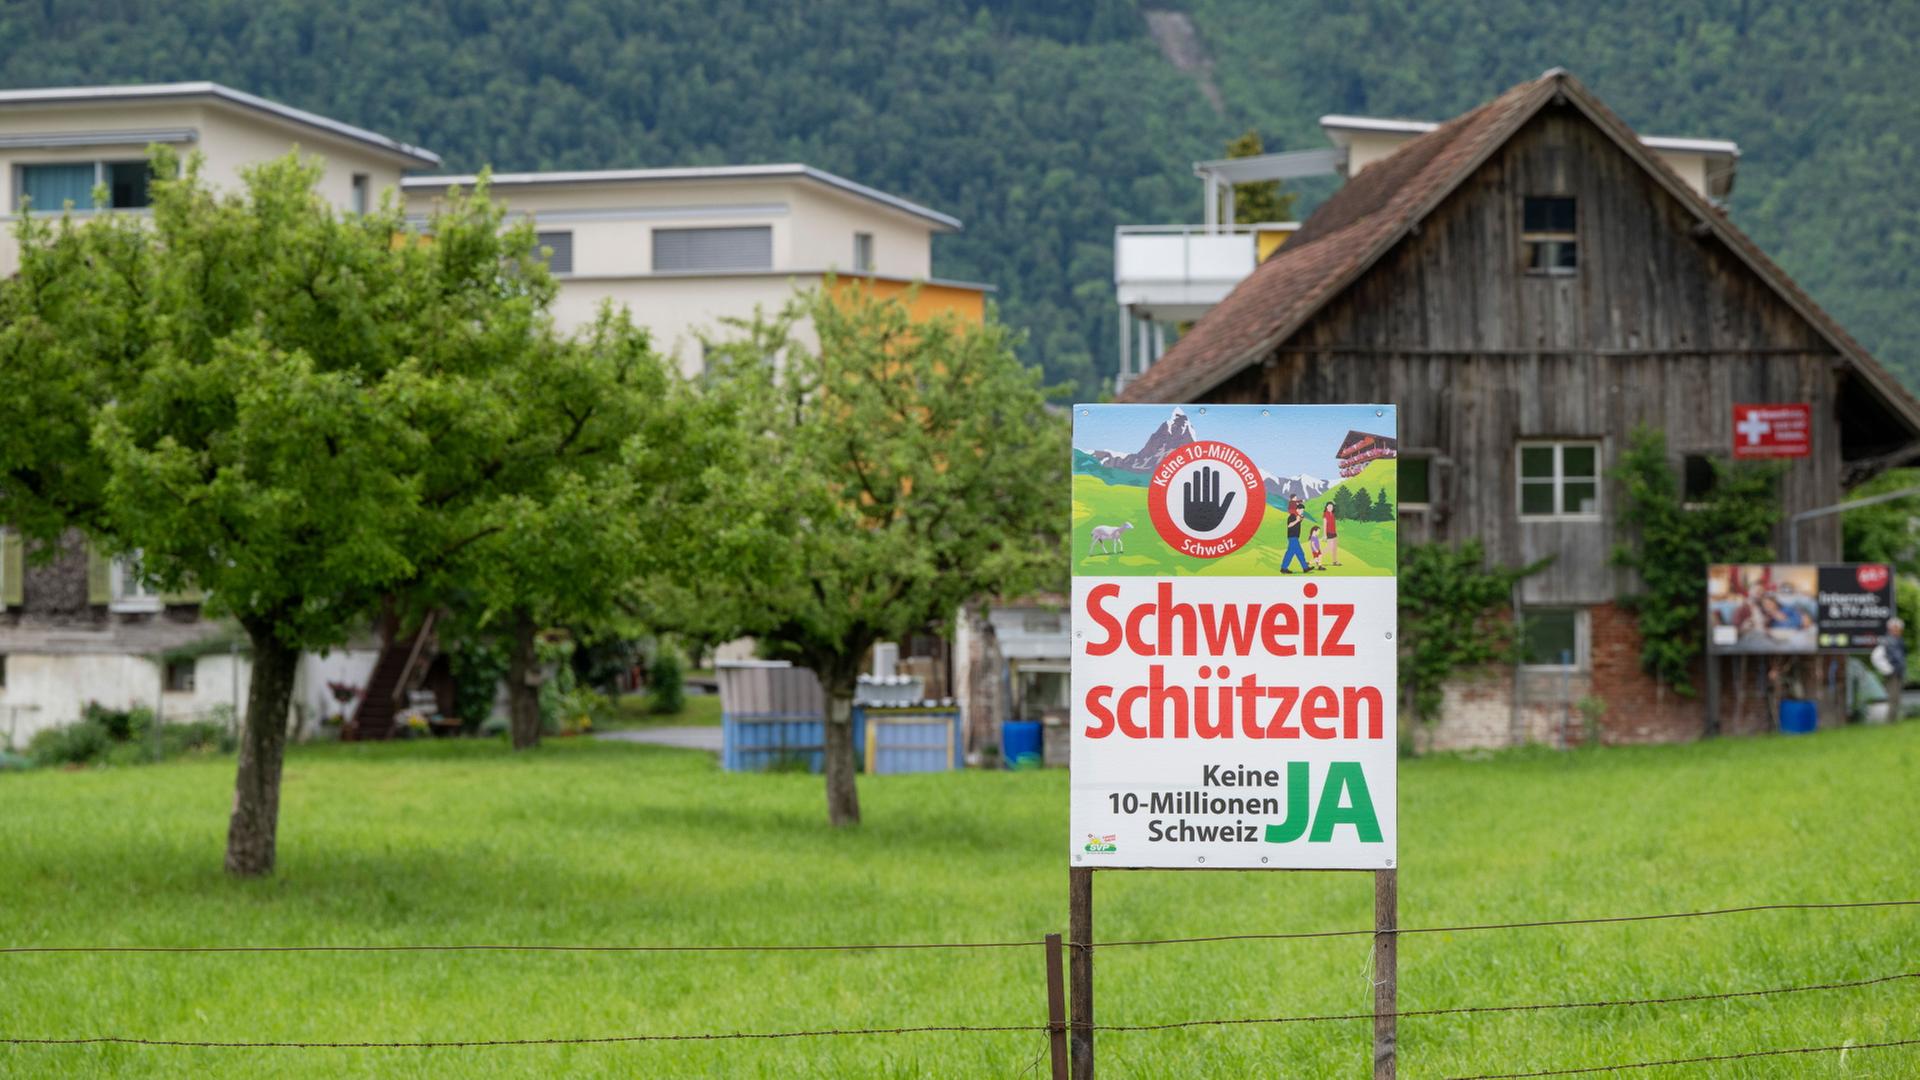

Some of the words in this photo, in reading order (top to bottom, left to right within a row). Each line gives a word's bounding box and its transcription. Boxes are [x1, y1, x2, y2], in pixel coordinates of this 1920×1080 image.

[1153, 455, 1186, 487] Keine
[1185, 444, 1258, 489] 10-Millionen
[1181, 538, 1237, 556] Schweiz
[1085, 582, 1356, 657] Schweiz
[1084, 665, 1384, 740] schützen
[1203, 764, 1279, 787] Keine
[1109, 791, 1279, 815] 10-Millionen
[1264, 761, 1384, 844] JA
[1148, 819, 1258, 843] Schweiz
